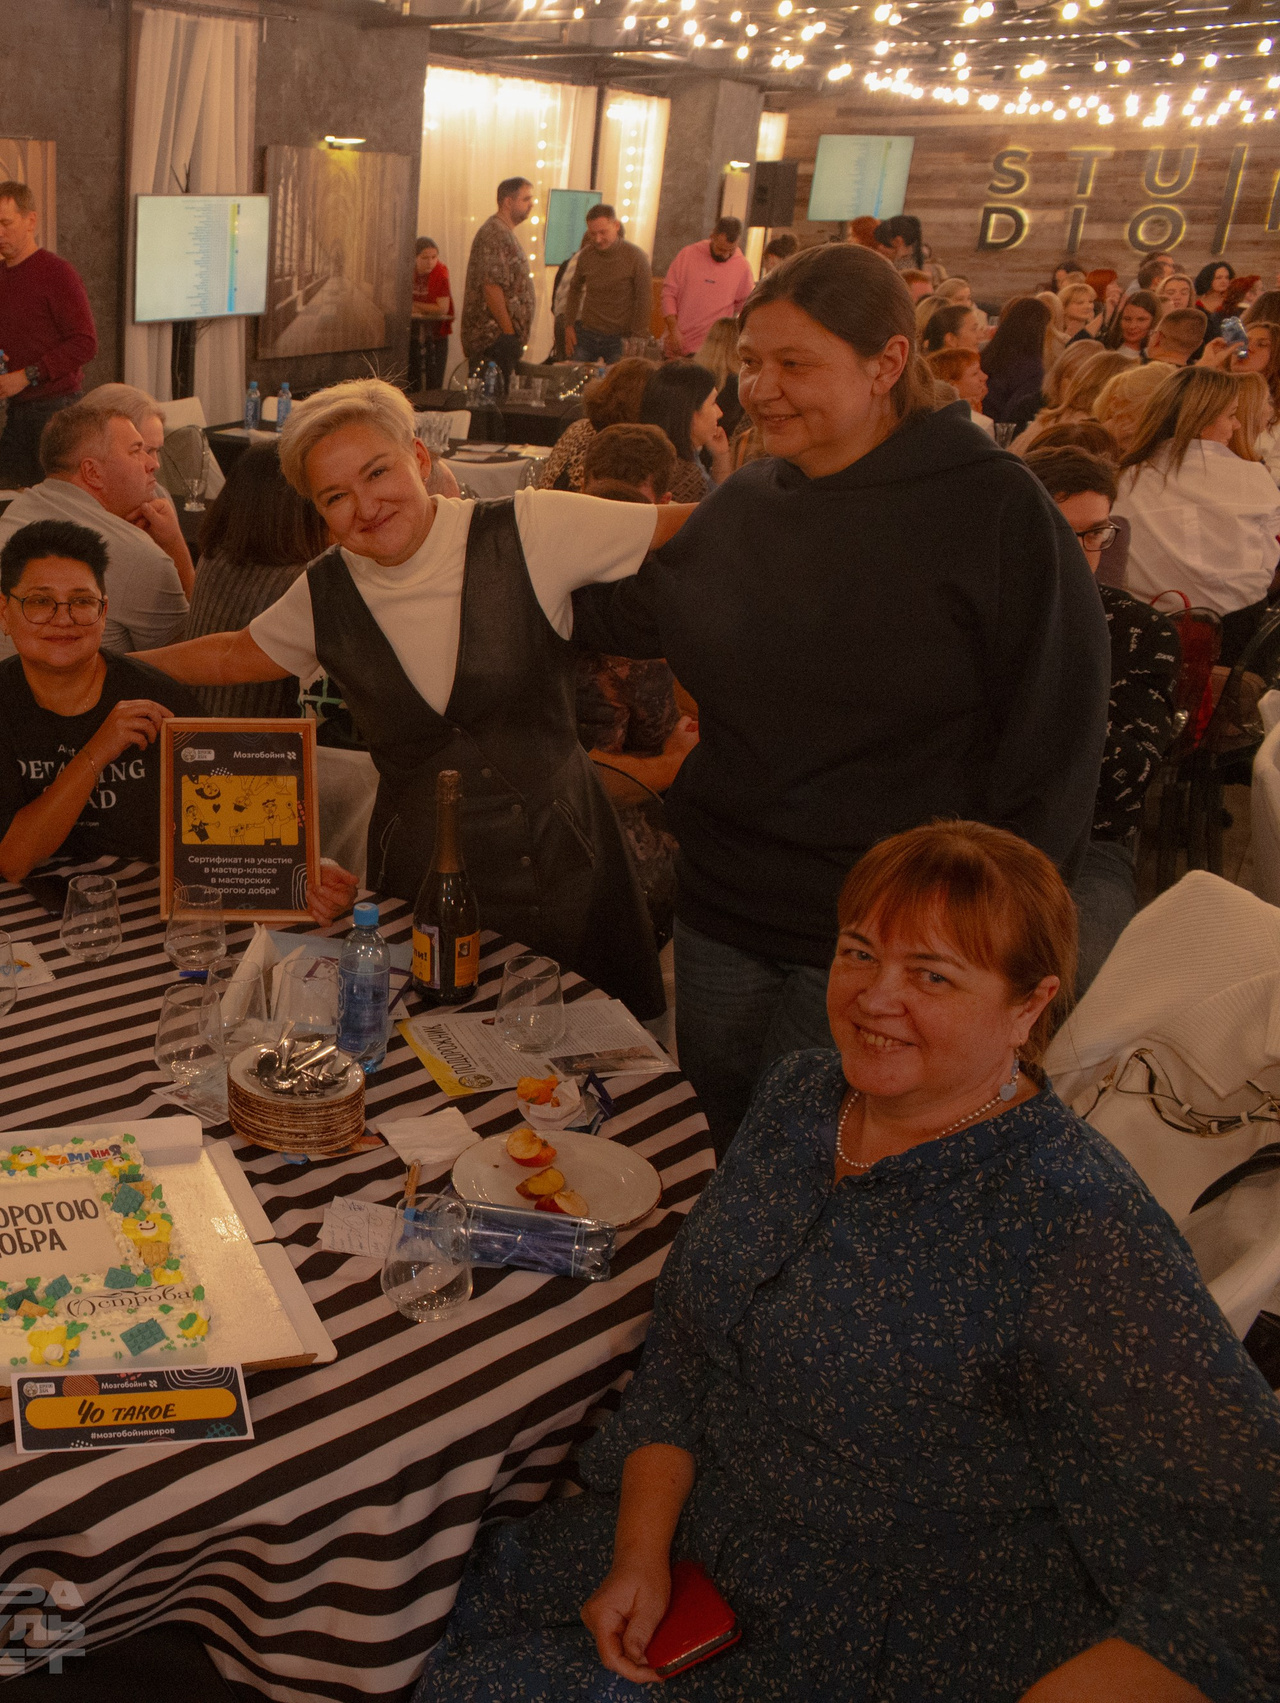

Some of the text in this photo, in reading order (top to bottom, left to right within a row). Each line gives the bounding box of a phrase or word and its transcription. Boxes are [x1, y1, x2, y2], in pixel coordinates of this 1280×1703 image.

[233, 750, 285, 760] Мозгобойня
[188, 855, 242, 865] Сертификат
[257, 857, 293, 867] участие
[212, 867, 277, 876] мастер-классе
[218, 877, 271, 886] мастерских
[101, 1380, 147, 1391] Мозгобойня
[91, 1427, 175, 1440] #мозгобойнякиров
